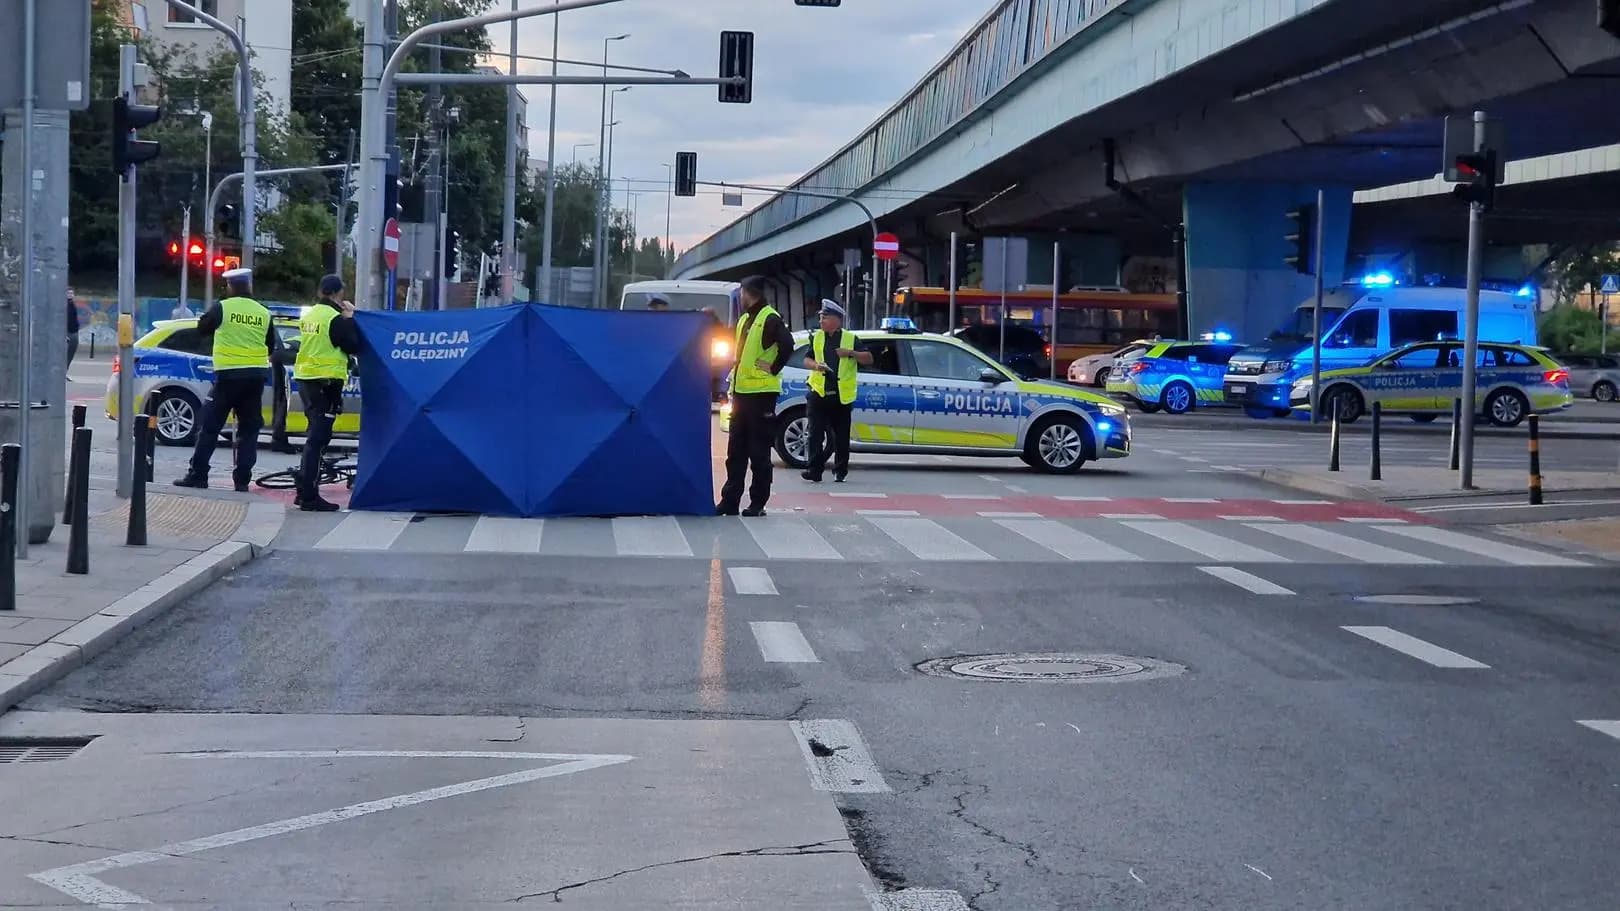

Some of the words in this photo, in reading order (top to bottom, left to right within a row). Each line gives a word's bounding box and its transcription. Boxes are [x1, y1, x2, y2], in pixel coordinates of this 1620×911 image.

[230, 312, 263, 326] POLICJA
[393, 330, 470, 345] POLICJA
[390, 346, 468, 362] OGLĘDZINY
[1375, 376, 1416, 387] POLICJA
[944, 393, 1012, 413] POLICJA
